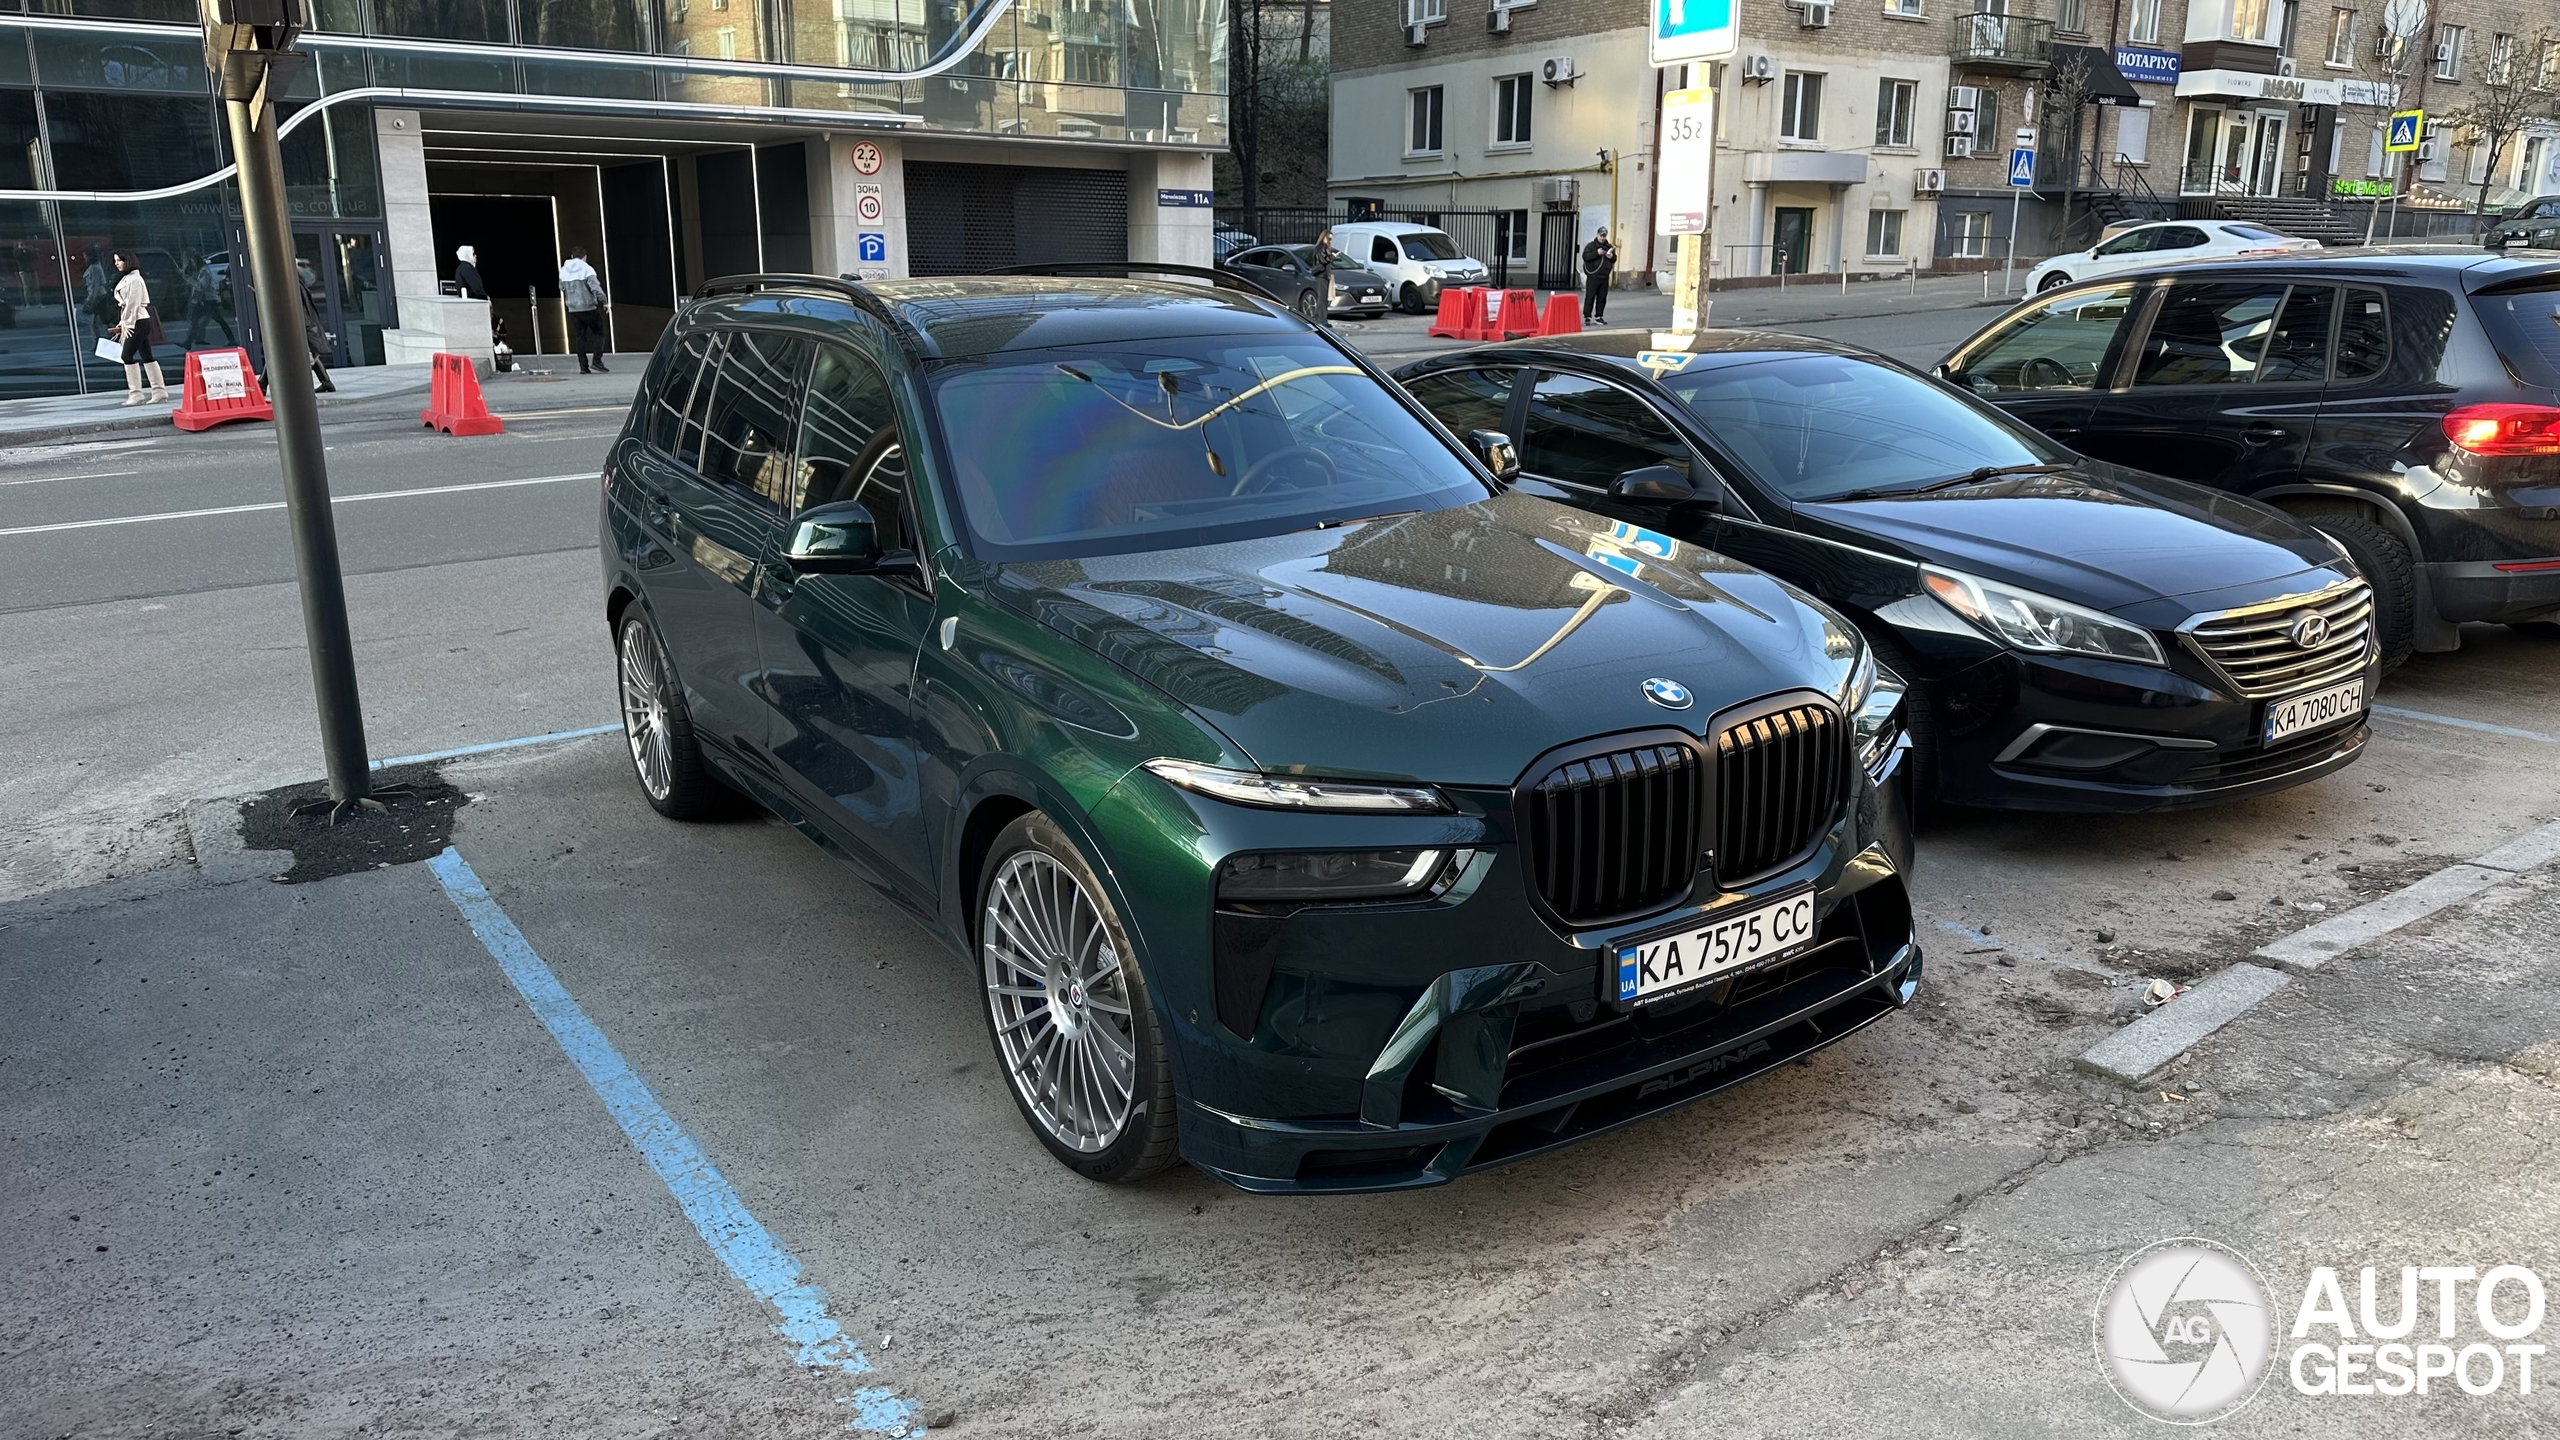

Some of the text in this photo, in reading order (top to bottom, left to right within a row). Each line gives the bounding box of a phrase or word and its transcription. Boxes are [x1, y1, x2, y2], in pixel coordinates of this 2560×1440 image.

[2117, 52, 2177, 71] НОТАРІУС
[2227, 78, 2252, 87] FLOWERS
[2313, 87, 2330, 95] GIFTS
[857, 148, 876, 162] 2,2
[857, 185, 880, 194] ЗОНА
[863, 203, 876, 213] 10
[866, 241, 879, 260] P
[2275, 685, 2361, 734] KA 7080 CH
[1640, 900, 1809, 987] KA 7575 CC
[1621, 980, 1636, 993] UA
[1637, 1039, 1771, 1099] ALPINA
